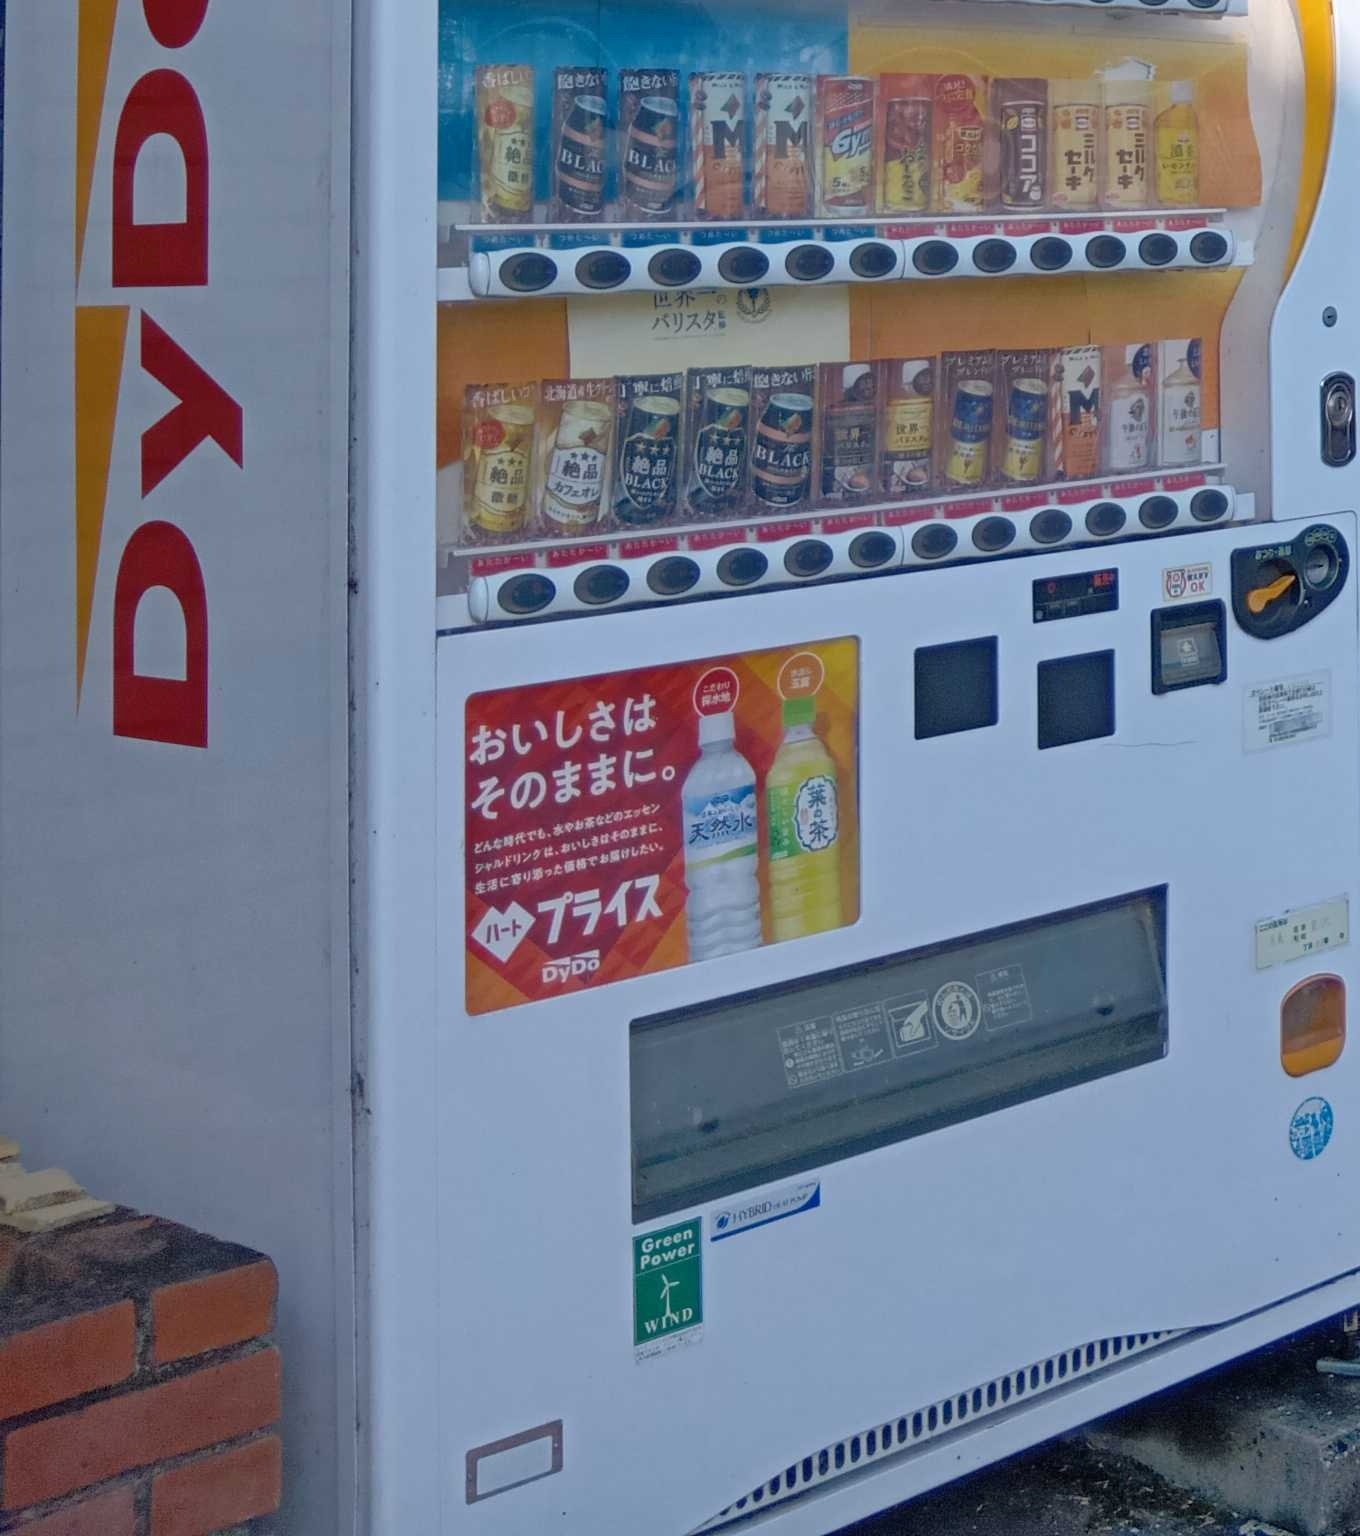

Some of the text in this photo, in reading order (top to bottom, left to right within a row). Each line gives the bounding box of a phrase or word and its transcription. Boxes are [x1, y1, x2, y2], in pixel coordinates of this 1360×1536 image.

[1020, 134, 1037, 193] ココア
[1065, 149, 1082, 191] セーキ
[1116, 149, 1133, 190] セーキ
[561, 459, 599, 480] 絶品
[469, 693, 658, 766] おいしさは
[471, 748, 676, 820] そのままに。
[688, 812, 753, 845] 天然水
[486, 874, 665, 945] ハート プライス
[640, 1242, 696, 1270] Power
[641, 1228, 694, 1254] Green
[644, 1307, 693, 1335] WIND
